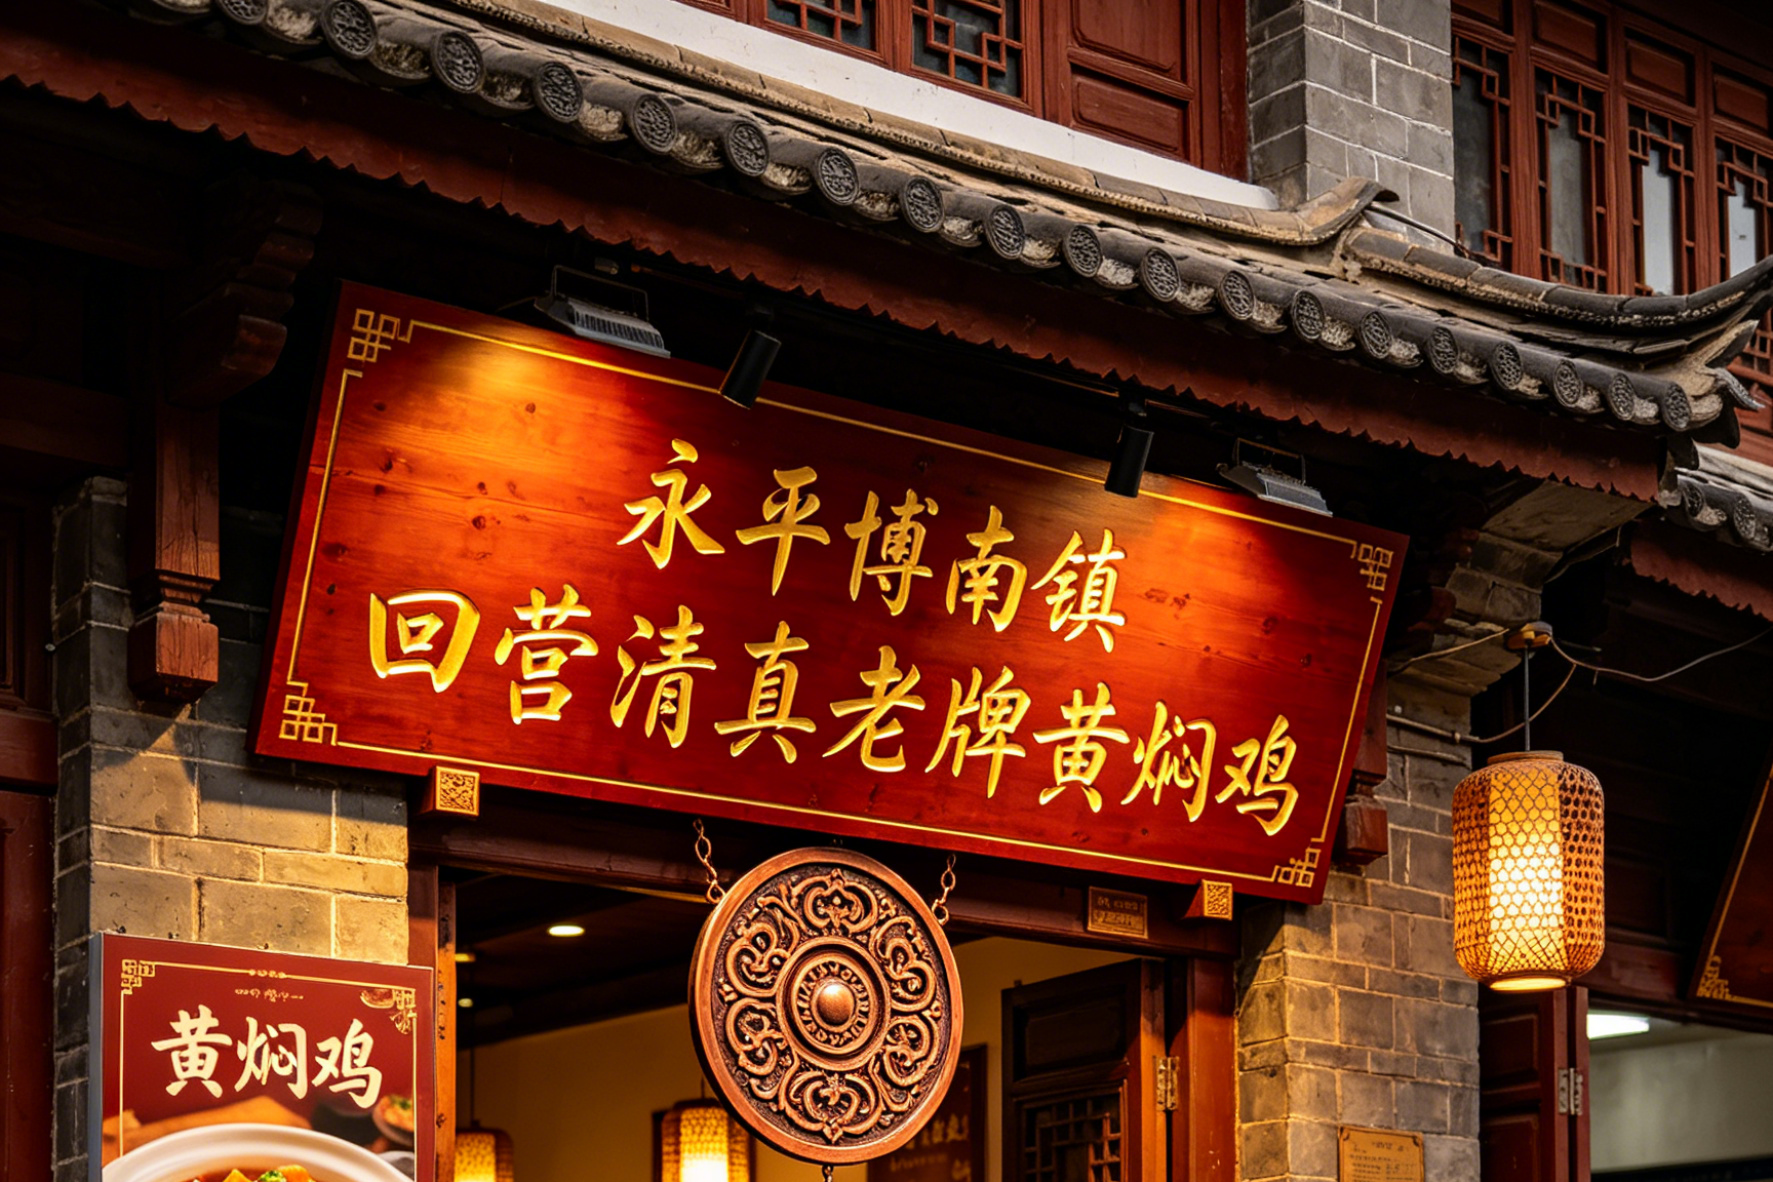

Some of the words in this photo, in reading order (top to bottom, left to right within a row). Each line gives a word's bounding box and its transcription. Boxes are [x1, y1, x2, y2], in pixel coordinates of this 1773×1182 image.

[617, 440, 1127, 653] 永平博南镇
[369, 583, 1299, 837] 回营清真老牌黄焖鸡
[150, 1004, 383, 1109] 黄焖鸡
